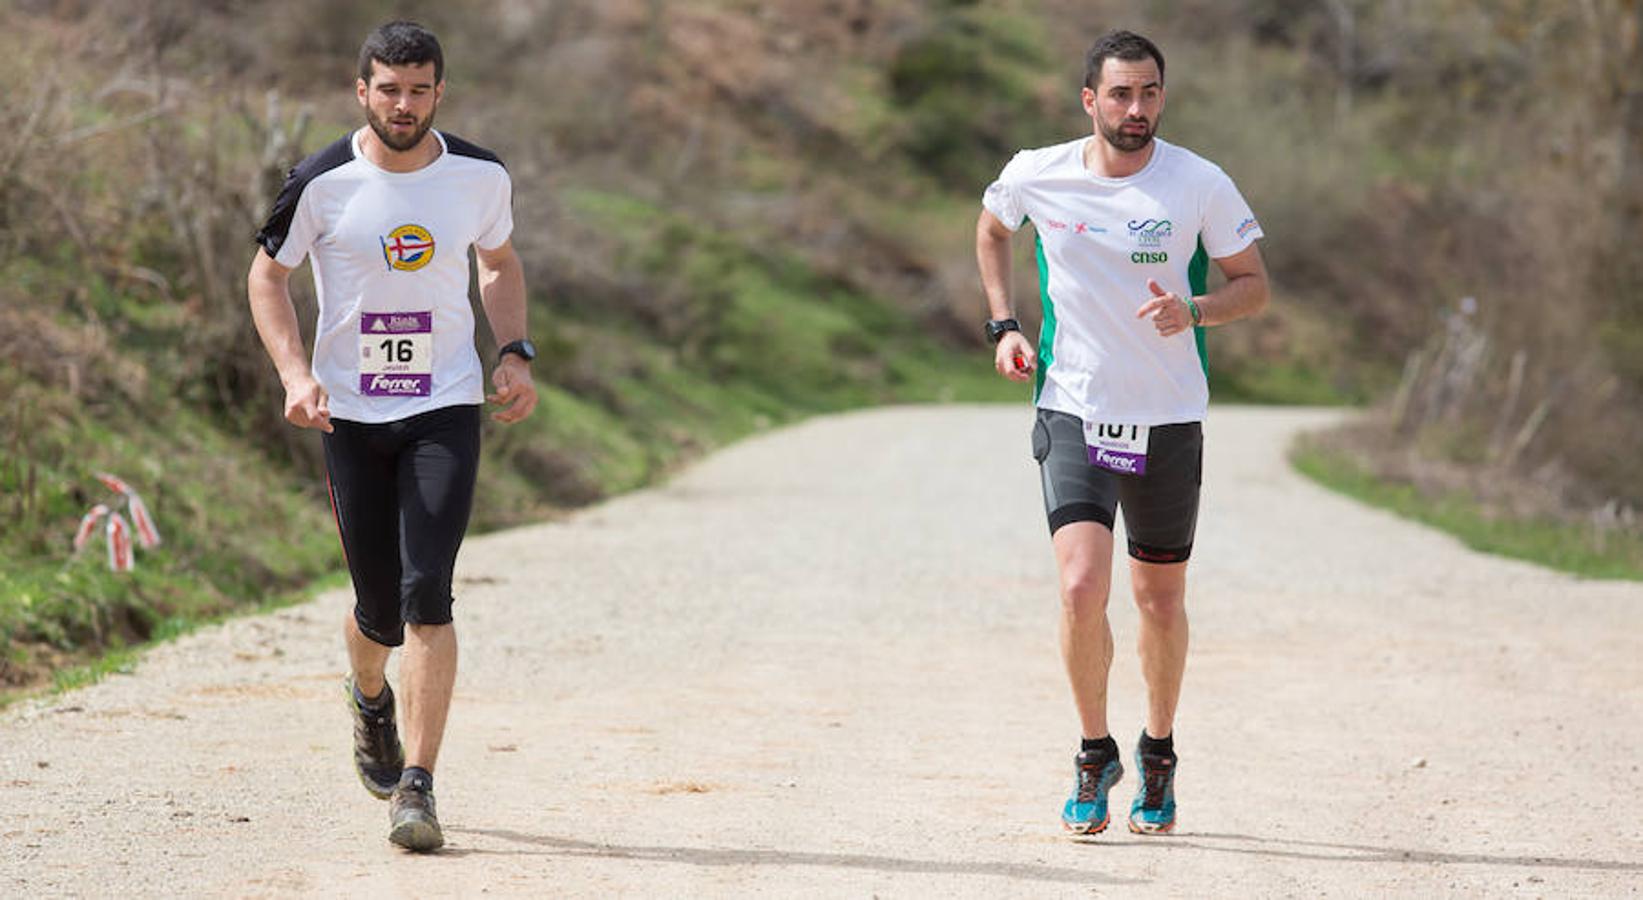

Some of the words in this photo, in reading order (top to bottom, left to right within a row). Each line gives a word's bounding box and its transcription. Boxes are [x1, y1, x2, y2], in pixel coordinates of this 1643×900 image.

[1131, 251, 1168, 264] cnso
[380, 339, 413, 363] 16
[370, 376, 421, 391] Ferrer
[1096, 448, 1136, 470] Ferrer
